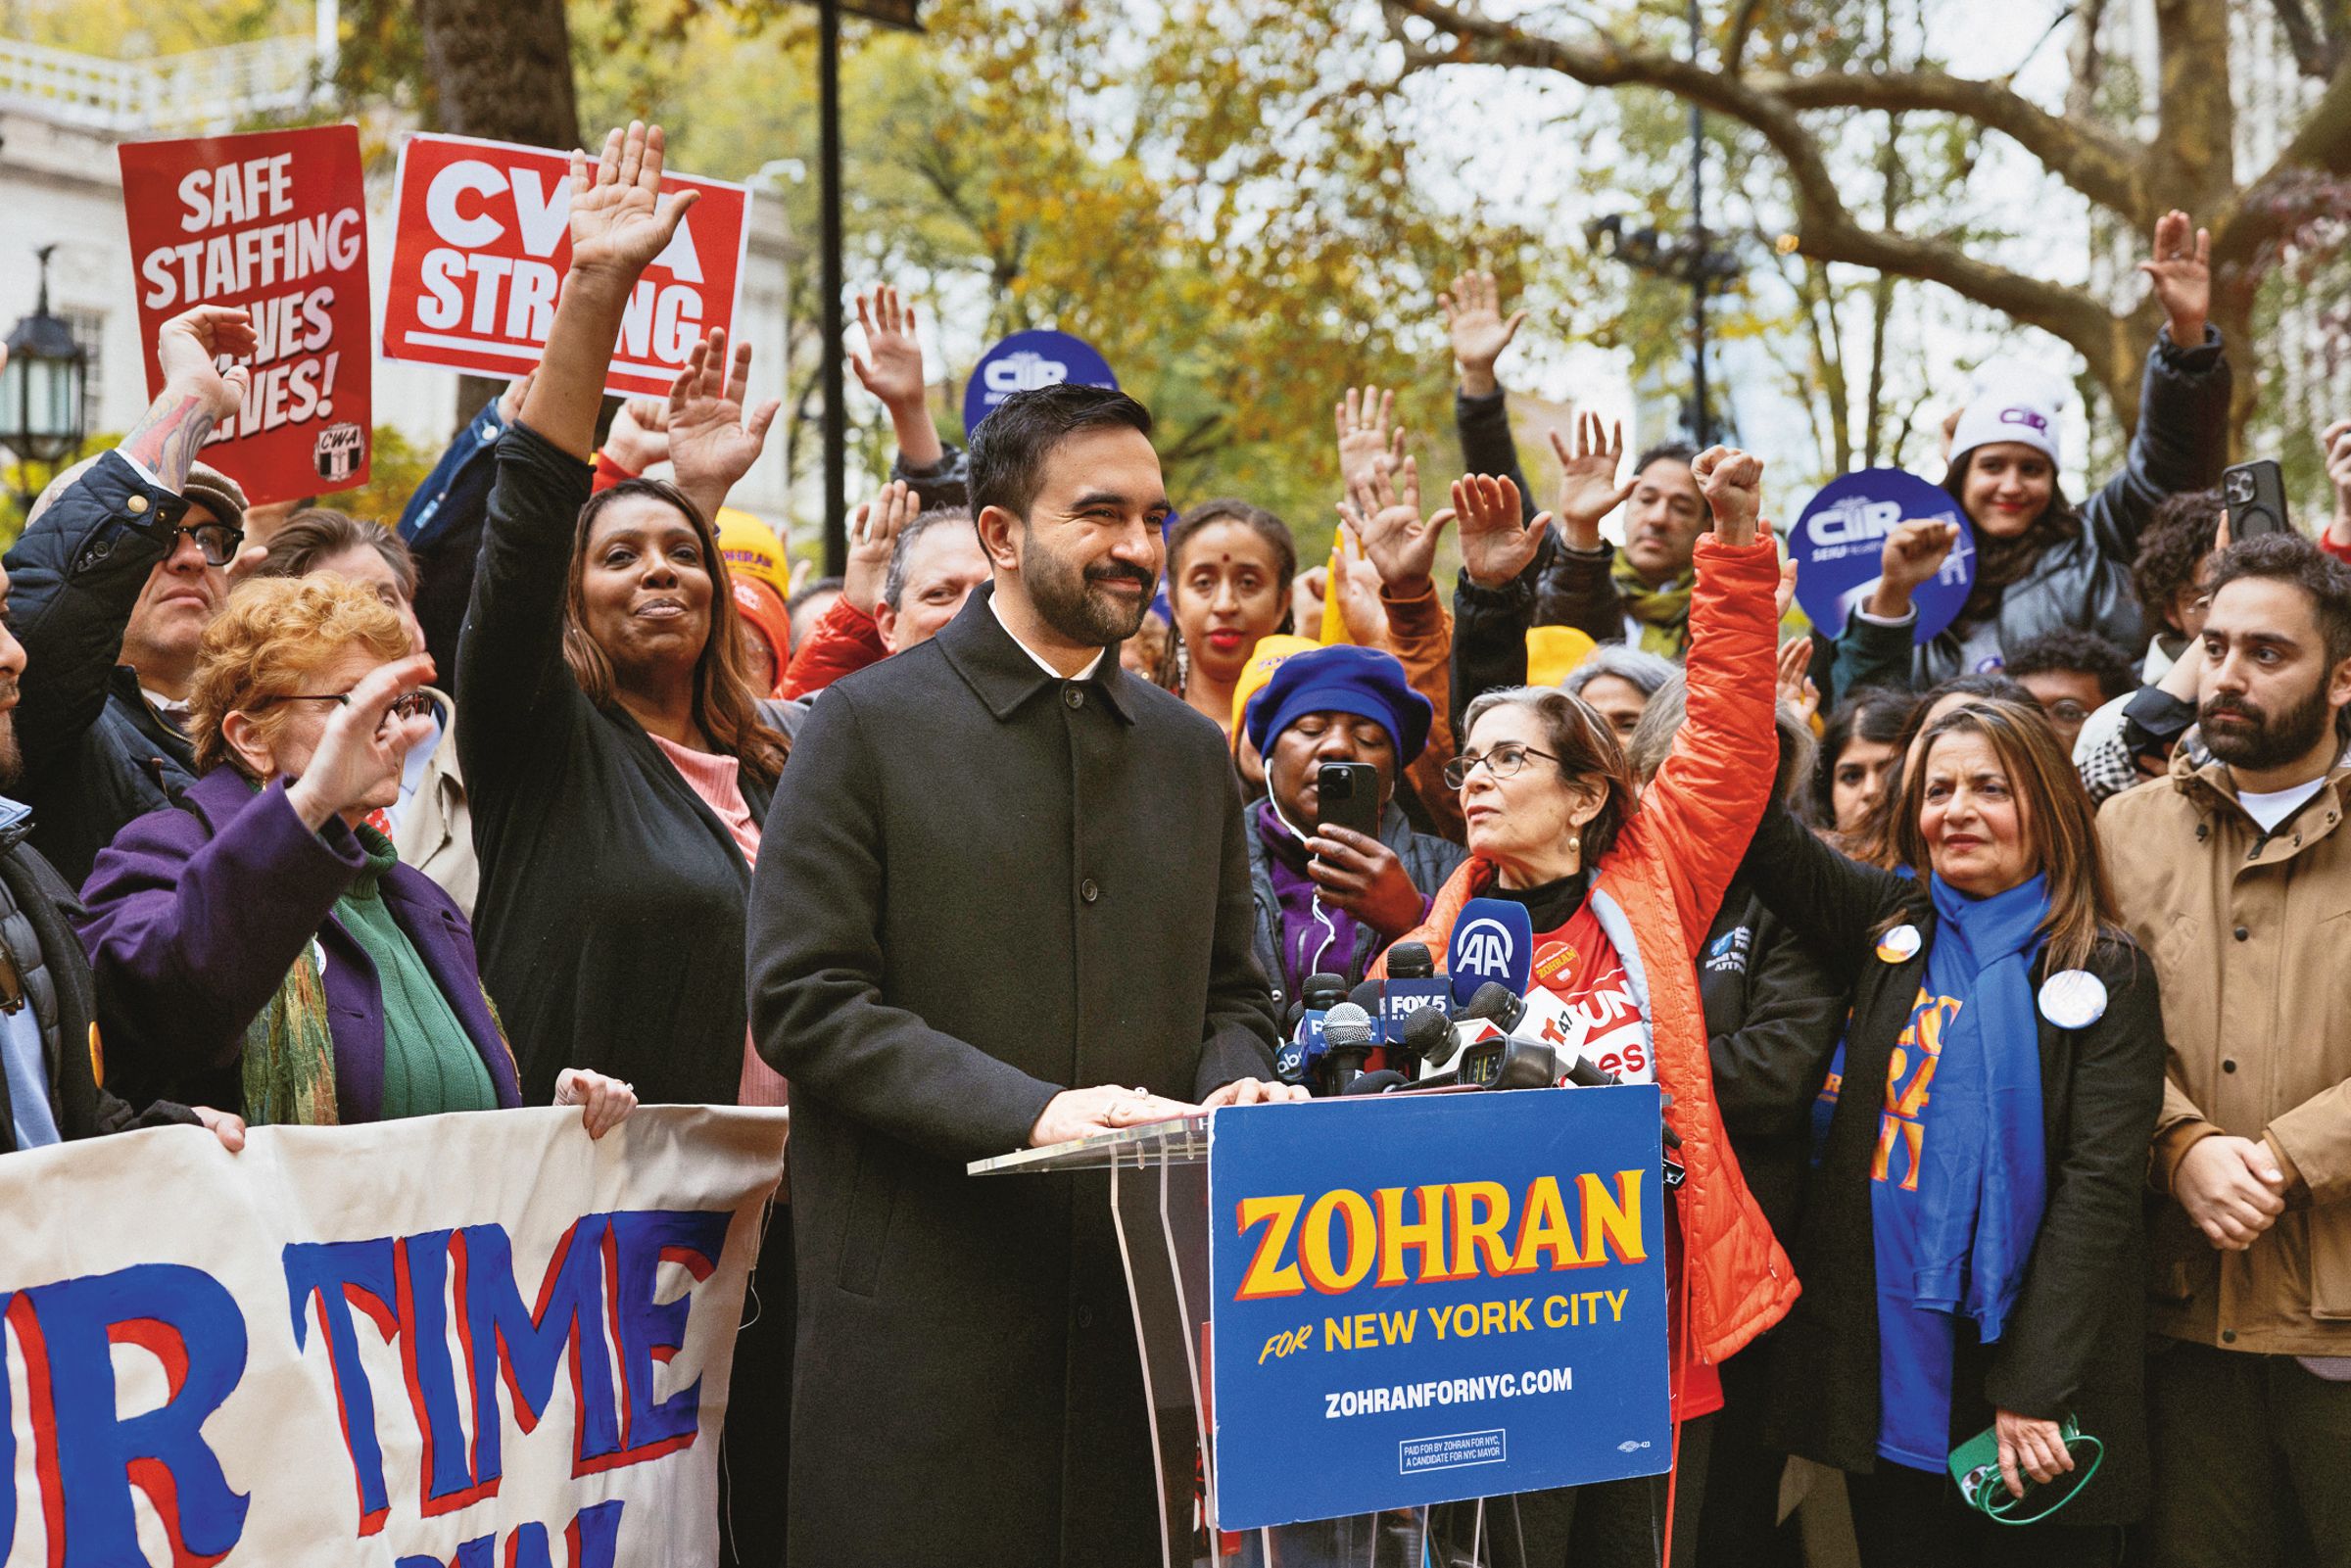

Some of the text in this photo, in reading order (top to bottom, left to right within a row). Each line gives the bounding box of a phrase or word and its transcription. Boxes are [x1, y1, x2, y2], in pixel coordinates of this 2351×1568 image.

[178, 152, 294, 233] SAFE
[141, 207, 361, 310] STAFFING
[416, 247, 704, 364] STRNG
[201, 351, 340, 446] VES!
[320, 429, 359, 451] CWA
[1456, 932, 1511, 978] AA
[1536, 948, 1577, 980] ZOHRAN
[1559, 1010, 1573, 1035] 47
[1591, 1043, 1646, 1076] es
[1233, 1169, 1650, 1302] ZOHRAN
[1258, 1289, 1630, 1365] FOR NEW YORK CITY
[283, 1210, 737, 1538] TIME
[1324, 1366, 1573, 1419] ZOHRANFORNYC.COM
[1404, 1445, 1420, 1456] PAID
[1420, 1444, 1433, 1454] FOR
[1434, 1443, 1443, 1452] BY
[1444, 1439, 1470, 1451] ZOHRAN
[1471, 1437, 1485, 1448] FOR
[1413, 1452, 1449, 1466] CANDIDATE
[1450, 1451, 1463, 1461] FOR
[1463, 1449, 1477, 1460] NYC
[1478, 1447, 1501, 1458] MAYOR
